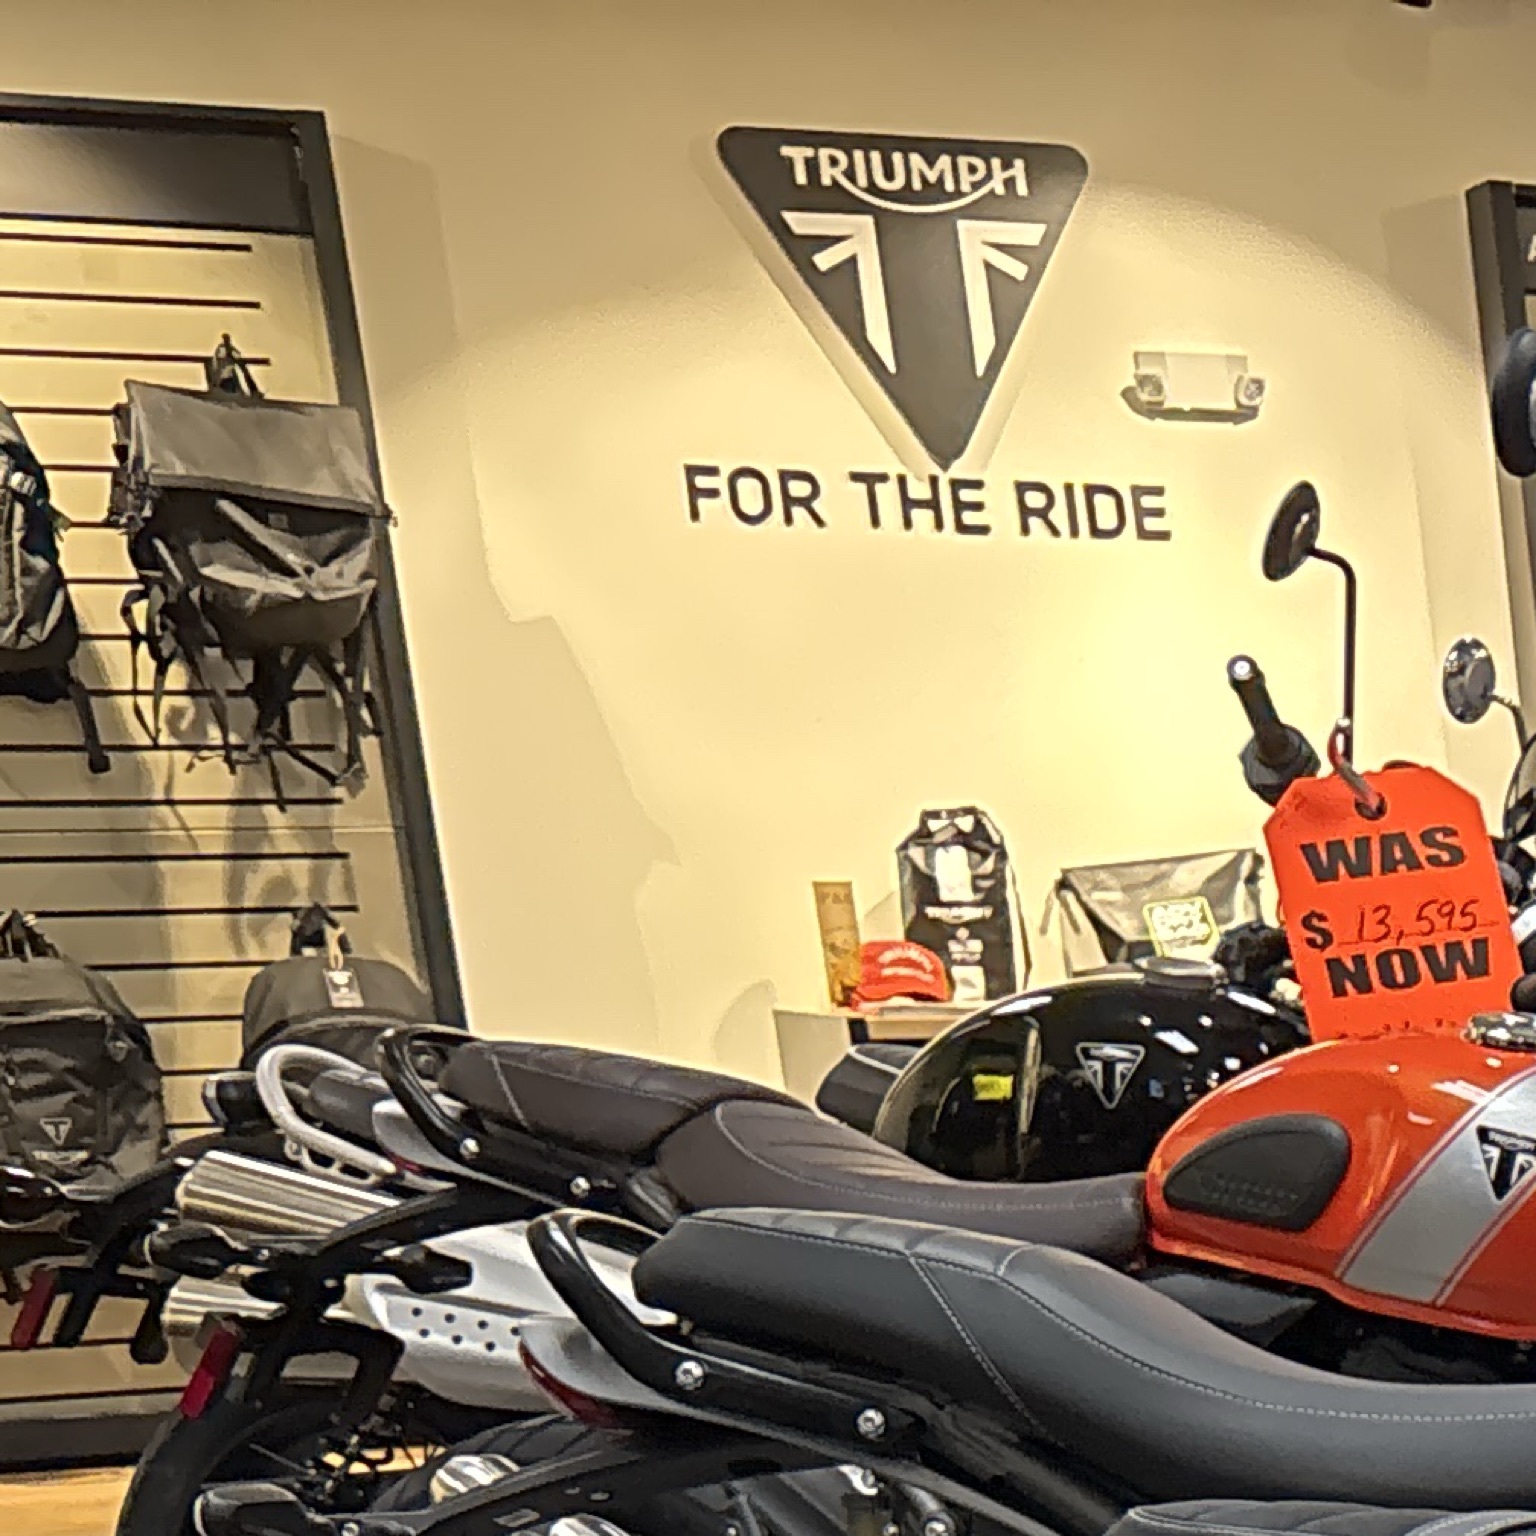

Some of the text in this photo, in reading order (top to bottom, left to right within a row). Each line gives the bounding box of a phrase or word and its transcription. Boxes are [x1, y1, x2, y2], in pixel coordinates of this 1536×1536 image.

[779, 144, 1031, 200] TRIUMPH
[683, 463, 1173, 541] FOR THE RIDE
[1299, 825, 1467, 884] WAS
[1326, 939, 1492, 999] NOW
